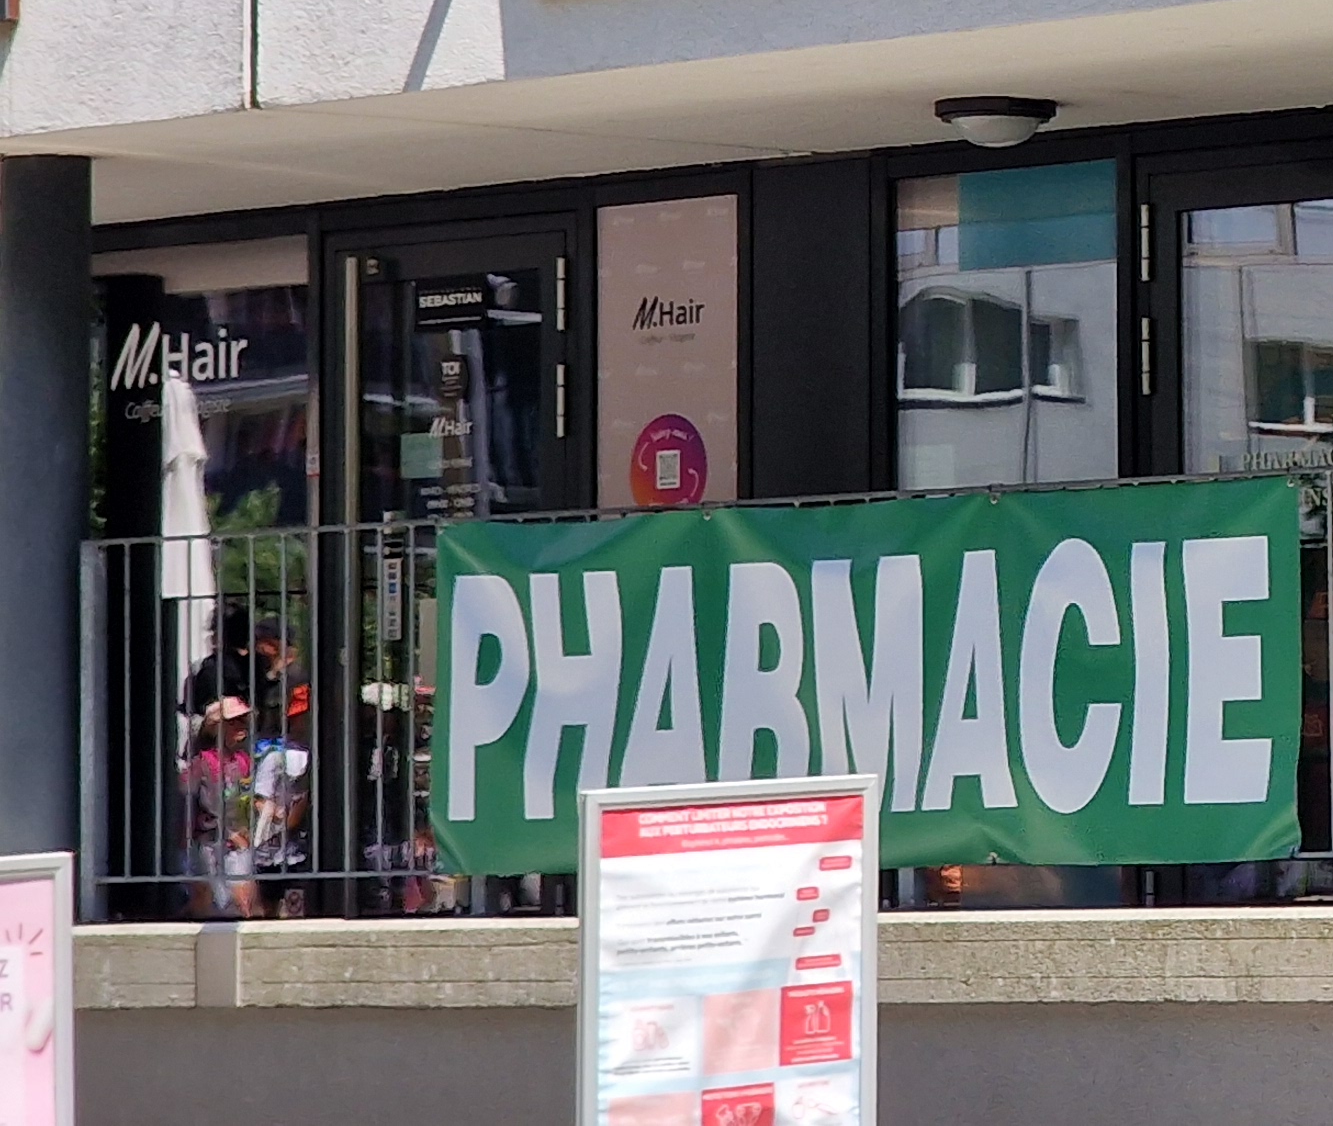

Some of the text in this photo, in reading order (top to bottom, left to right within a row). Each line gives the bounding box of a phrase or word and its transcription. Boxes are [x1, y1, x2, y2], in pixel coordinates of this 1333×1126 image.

[418, 292, 482, 308] SEBASTIAN
[632, 295, 706, 331] M.Hair
[110, 320, 249, 392] M.Hair
[447, 536, 1274, 822] PHARMACIE
